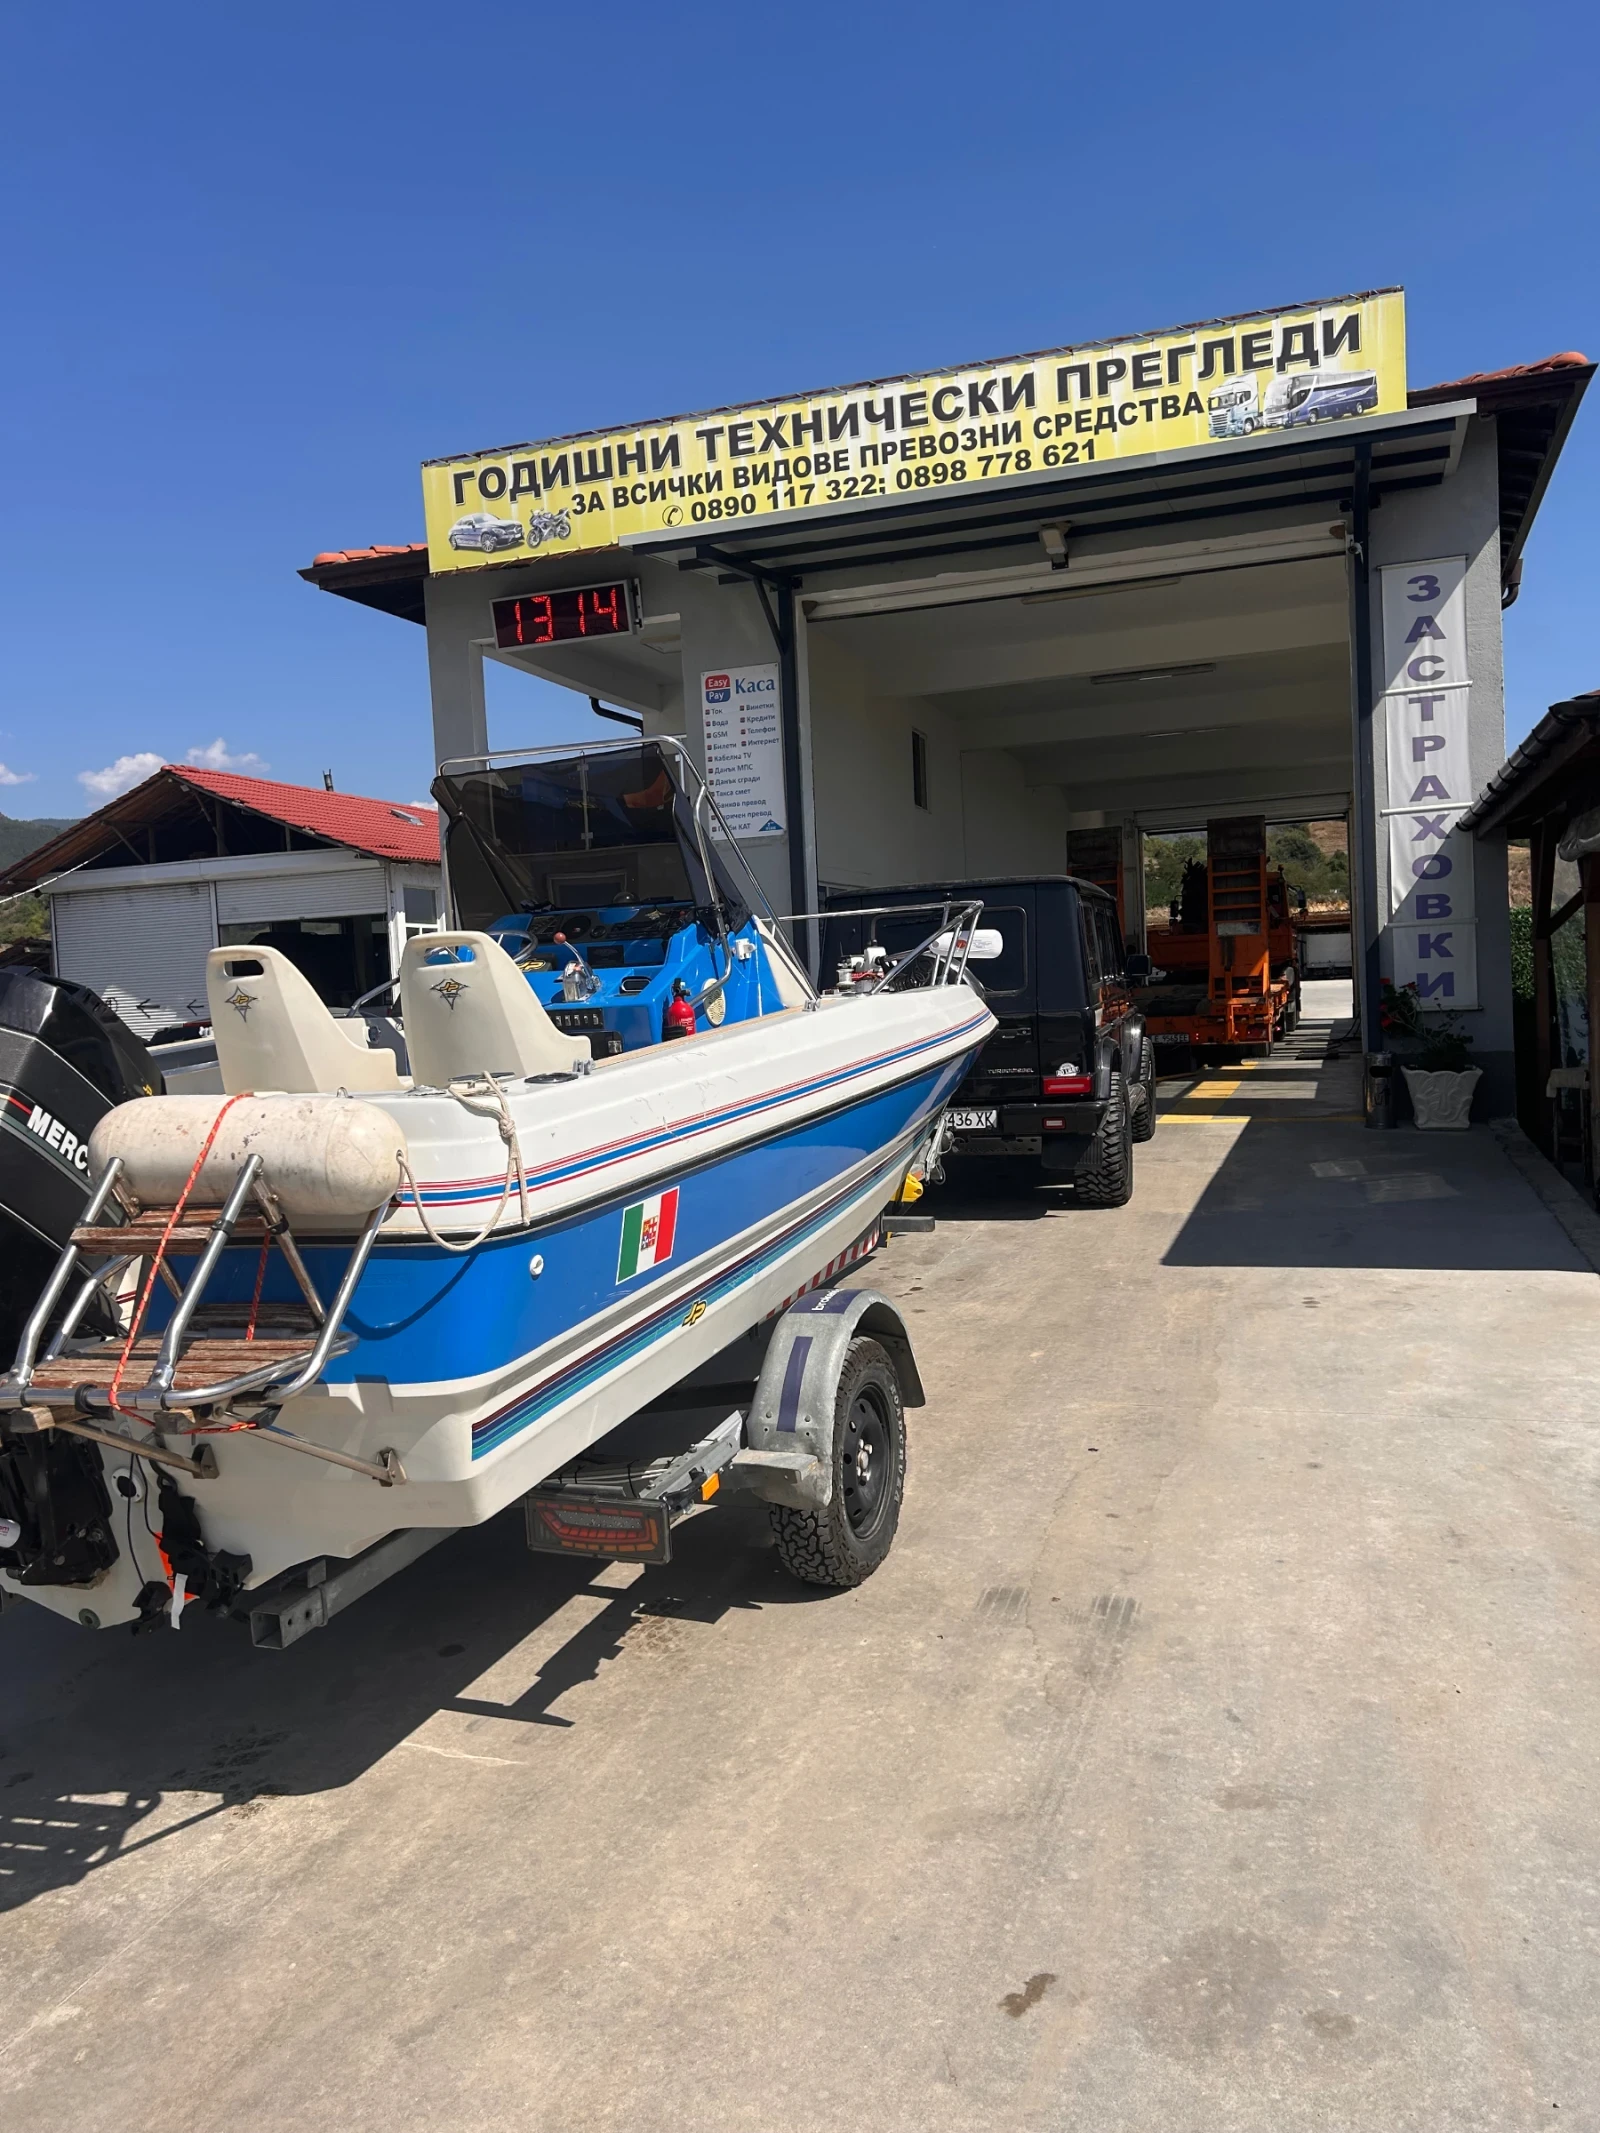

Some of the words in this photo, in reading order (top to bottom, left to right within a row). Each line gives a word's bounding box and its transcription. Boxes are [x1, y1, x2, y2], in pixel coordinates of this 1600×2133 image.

[453, 434, 680, 504] ГОДИШНИ
[696, 372, 1035, 461] ТЕХНИЧЕСКИ
[1057, 313, 1360, 402] ПРЕГЛЕДИ
[572, 491, 605, 515] ЗА
[613, 470, 723, 508] ВСИЧКИ
[734, 448, 850, 489] ВИДОВЕ
[860, 420, 1022, 468] ПРЕВОЗНИ
[1033, 391, 1204, 440] СРЕДСТВА
[691, 493, 756, 522] 0890
[767, 483, 815, 510] 117
[896, 460, 967, 490] 0898
[977, 449, 1032, 477] 778
[1043, 438, 1095, 467] 621
[708, 678, 728, 688] Easy
[735, 678, 775, 694] Каса
[709, 691, 725, 701] Pay
[746, 703, 774, 711] Винетки
[746, 714, 776, 723] Кредити
[747, 726, 776, 735] Телефон
[748, 738, 780, 746] Интернет
[714, 753, 742, 762] Кабелна
[737, 763, 753, 771] МПС
[738, 776, 761, 784] сгради
[1403, 574, 1456, 998] ЗАСТРАХОВКИ
[716, 801, 740, 809] Банков
[742, 799, 767, 807] превод
[747, 810, 772, 818] превод
[738, 822, 751, 830] КАТ
[27, 1104, 91, 1178] MERC
